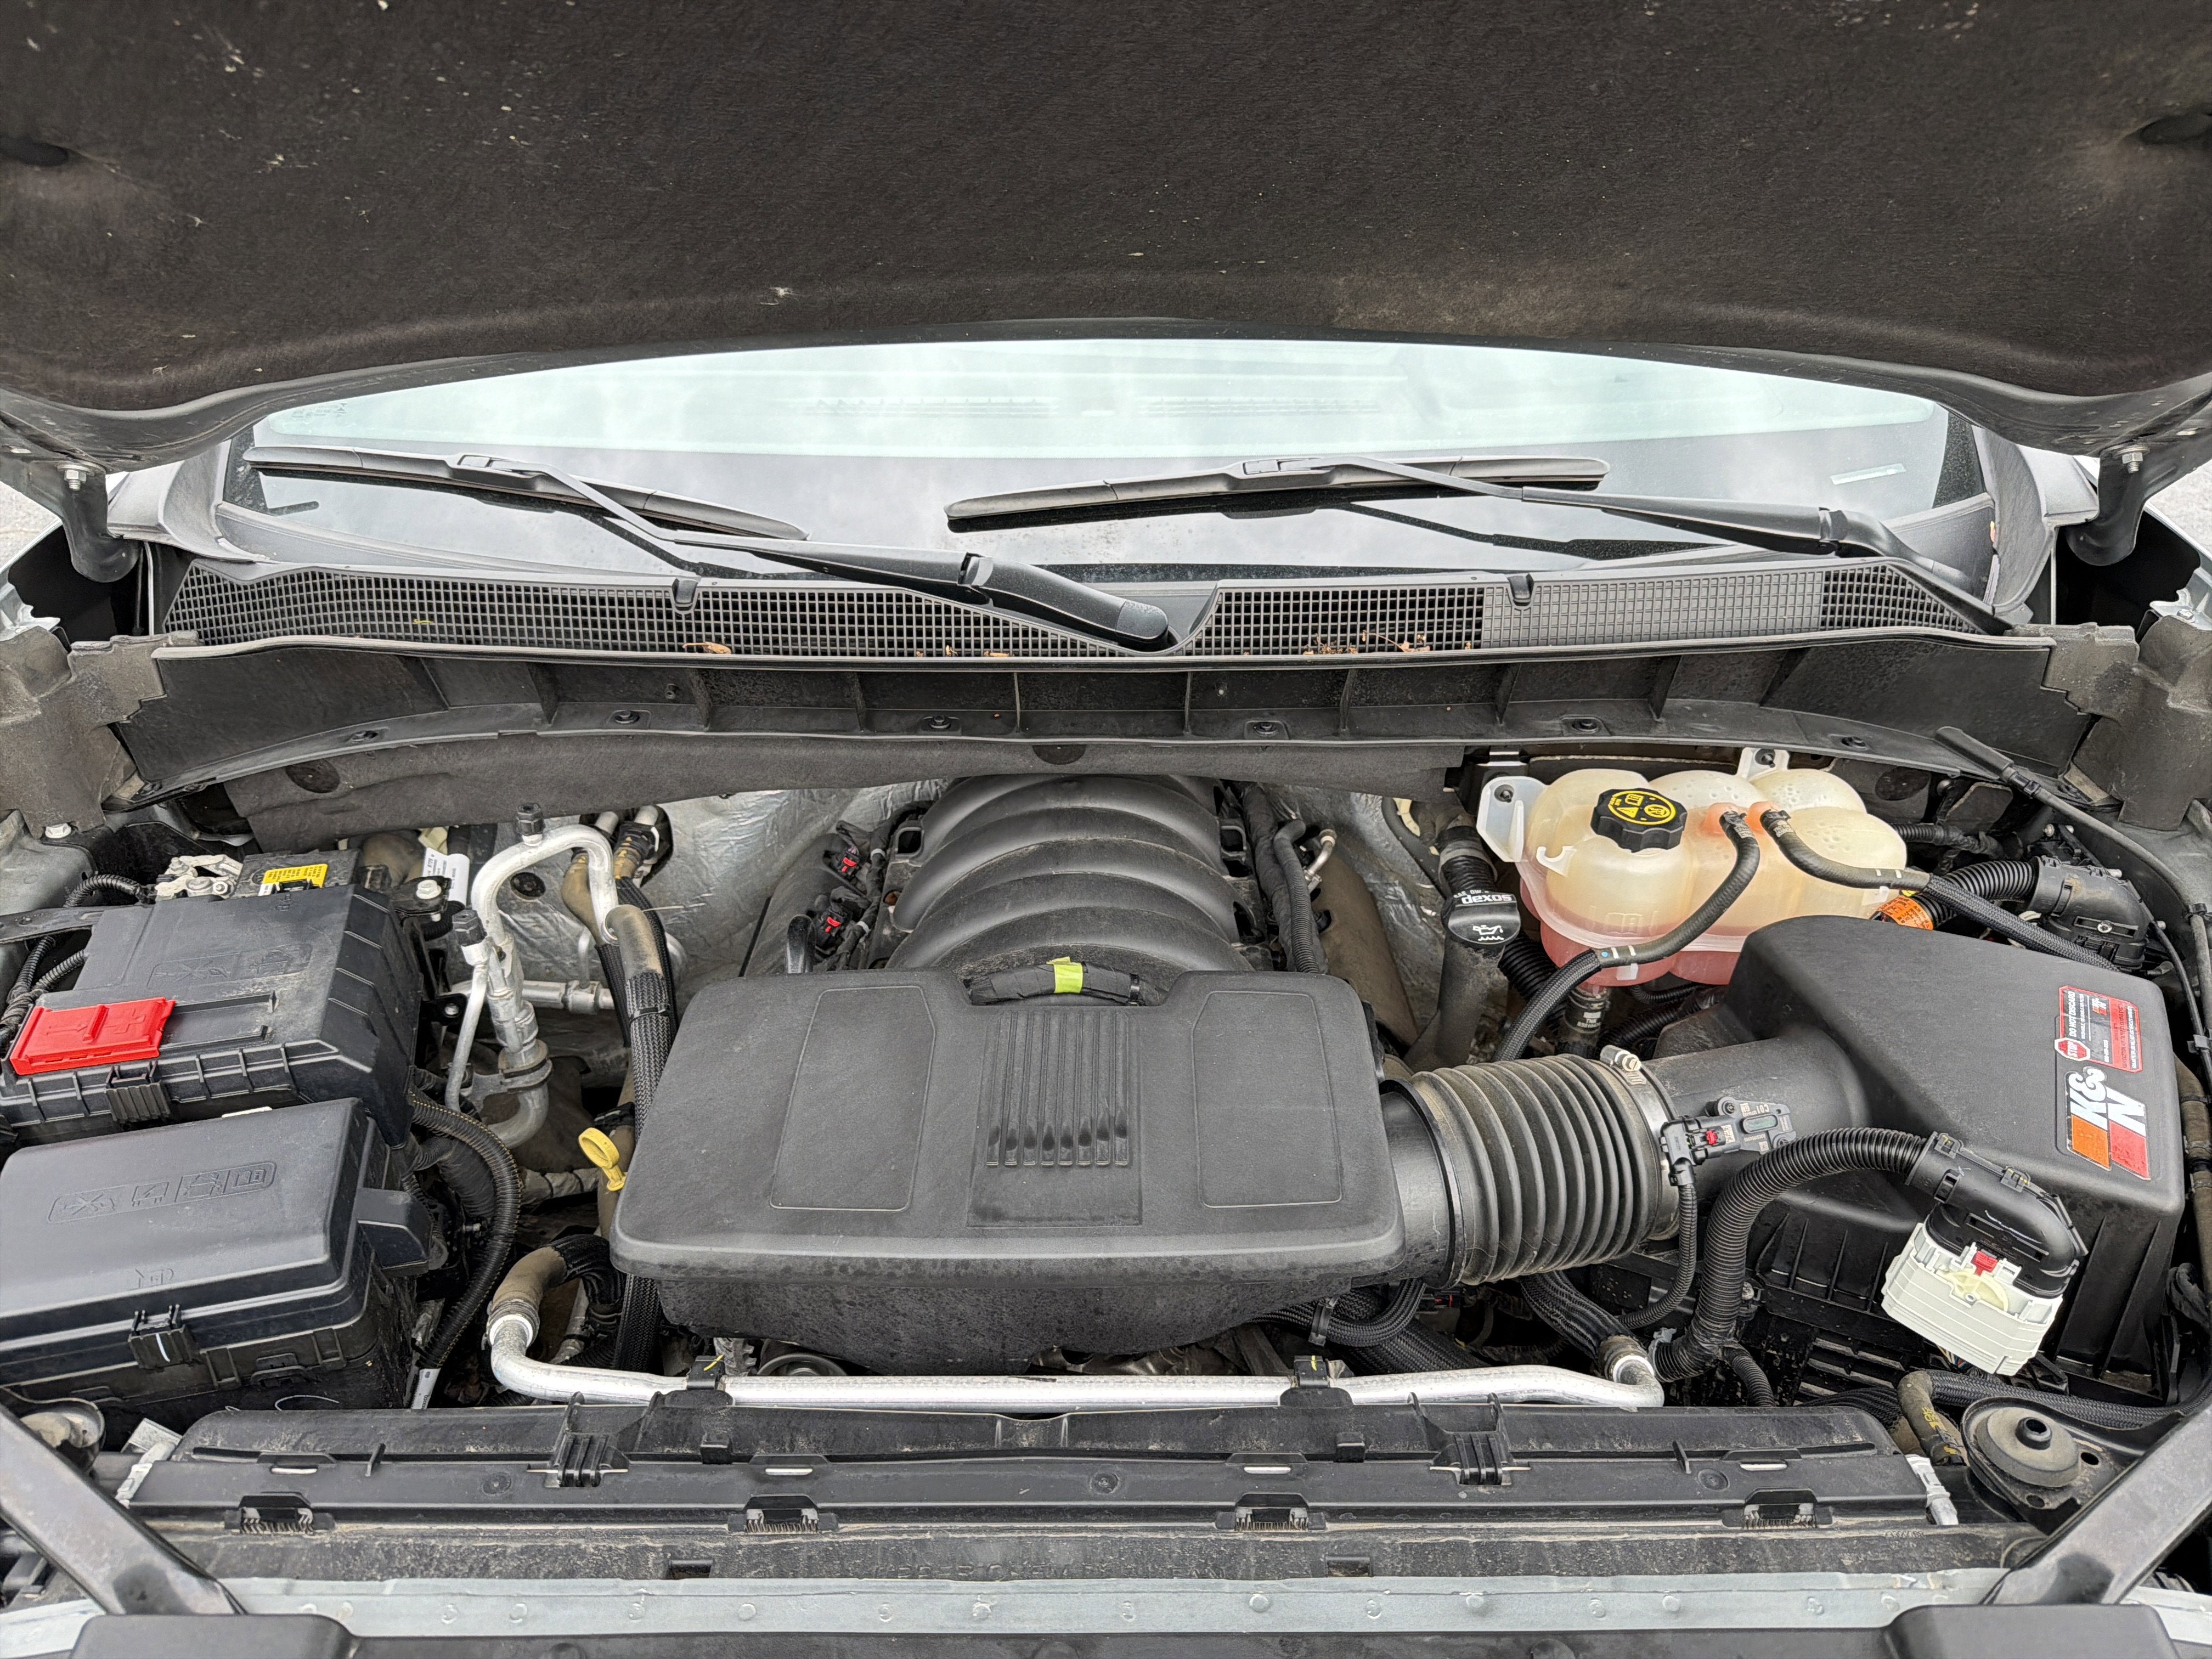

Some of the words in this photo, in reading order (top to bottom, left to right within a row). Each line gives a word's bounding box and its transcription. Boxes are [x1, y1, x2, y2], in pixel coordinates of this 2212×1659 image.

[1462, 894, 1513, 904] dexos
[2068, 991, 2076, 1015] DISCARD
[2068, 1014, 2076, 1028] NOT
[2069, 1029, 2077, 1037] DO
[2067, 1041, 2078, 1058] STOP
[1740, 1105, 1750, 1113] GM
[2068, 1068, 2146, 1138] K&N
